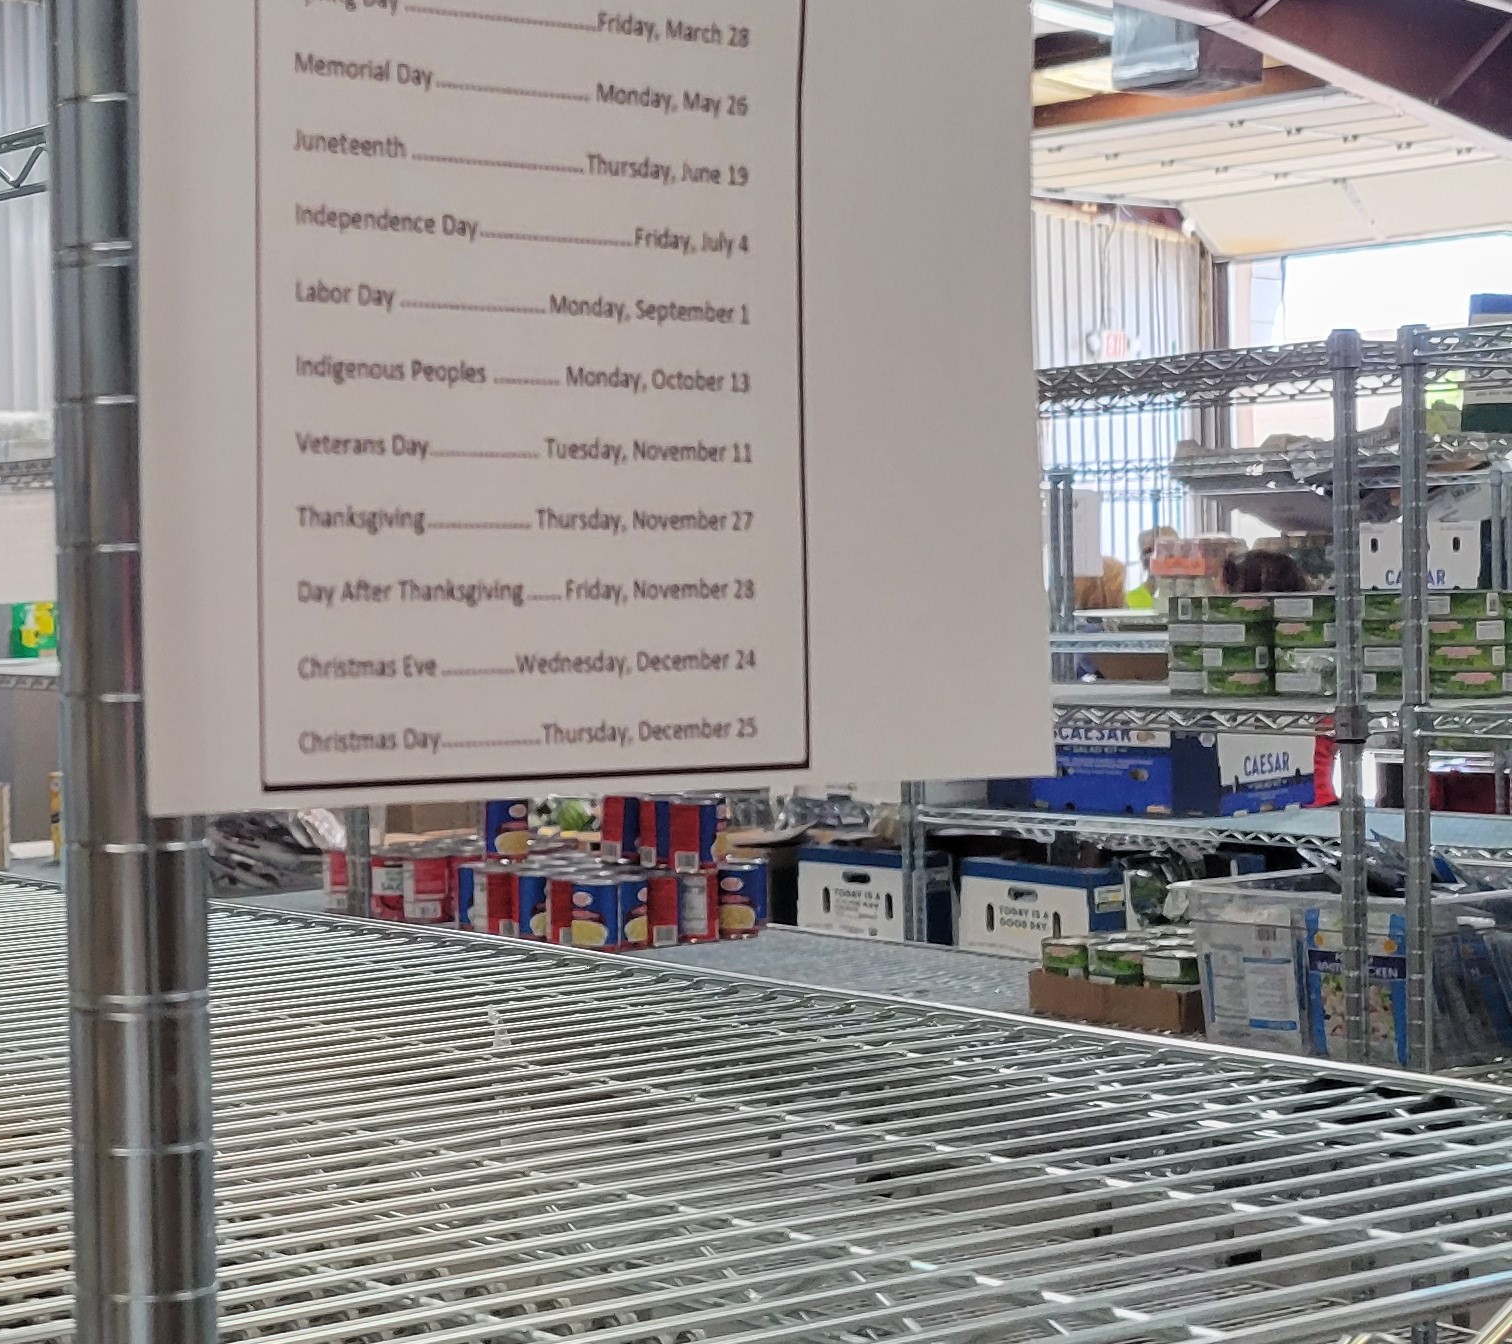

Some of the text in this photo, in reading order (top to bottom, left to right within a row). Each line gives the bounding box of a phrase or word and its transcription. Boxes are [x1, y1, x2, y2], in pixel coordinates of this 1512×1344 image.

[596, 11, 660, 43] Friday,
[665, 20, 723, 46] March
[728, 26, 750, 48] 28
[294, 52, 749, 120] Memorial Day Monday, May 26
[294, 128, 749, 187] Juneteenth Thursday, June 19
[295, 203, 750, 258] Independence Day Friday, July 4
[295, 281, 750, 329] Labor Day Monday, September 1
[295, 356, 750, 394] Indigenous Peoples Monday, October 13
[295, 432, 753, 464] Veterans Day Tuesday, November 11
[296, 505, 754, 537] Thanksgiving Thursday, November 27
[297, 578, 755, 609] Day After Thanksgiving Friday, November 28
[1385, 569, 1446, 586] CAAR
[297, 649, 756, 682] Christmas Eve Wednesday, December 24
[297, 717, 758, 754] Christmas Day Thursday, December 25
[1242, 752, 1290, 778] CAESAR
